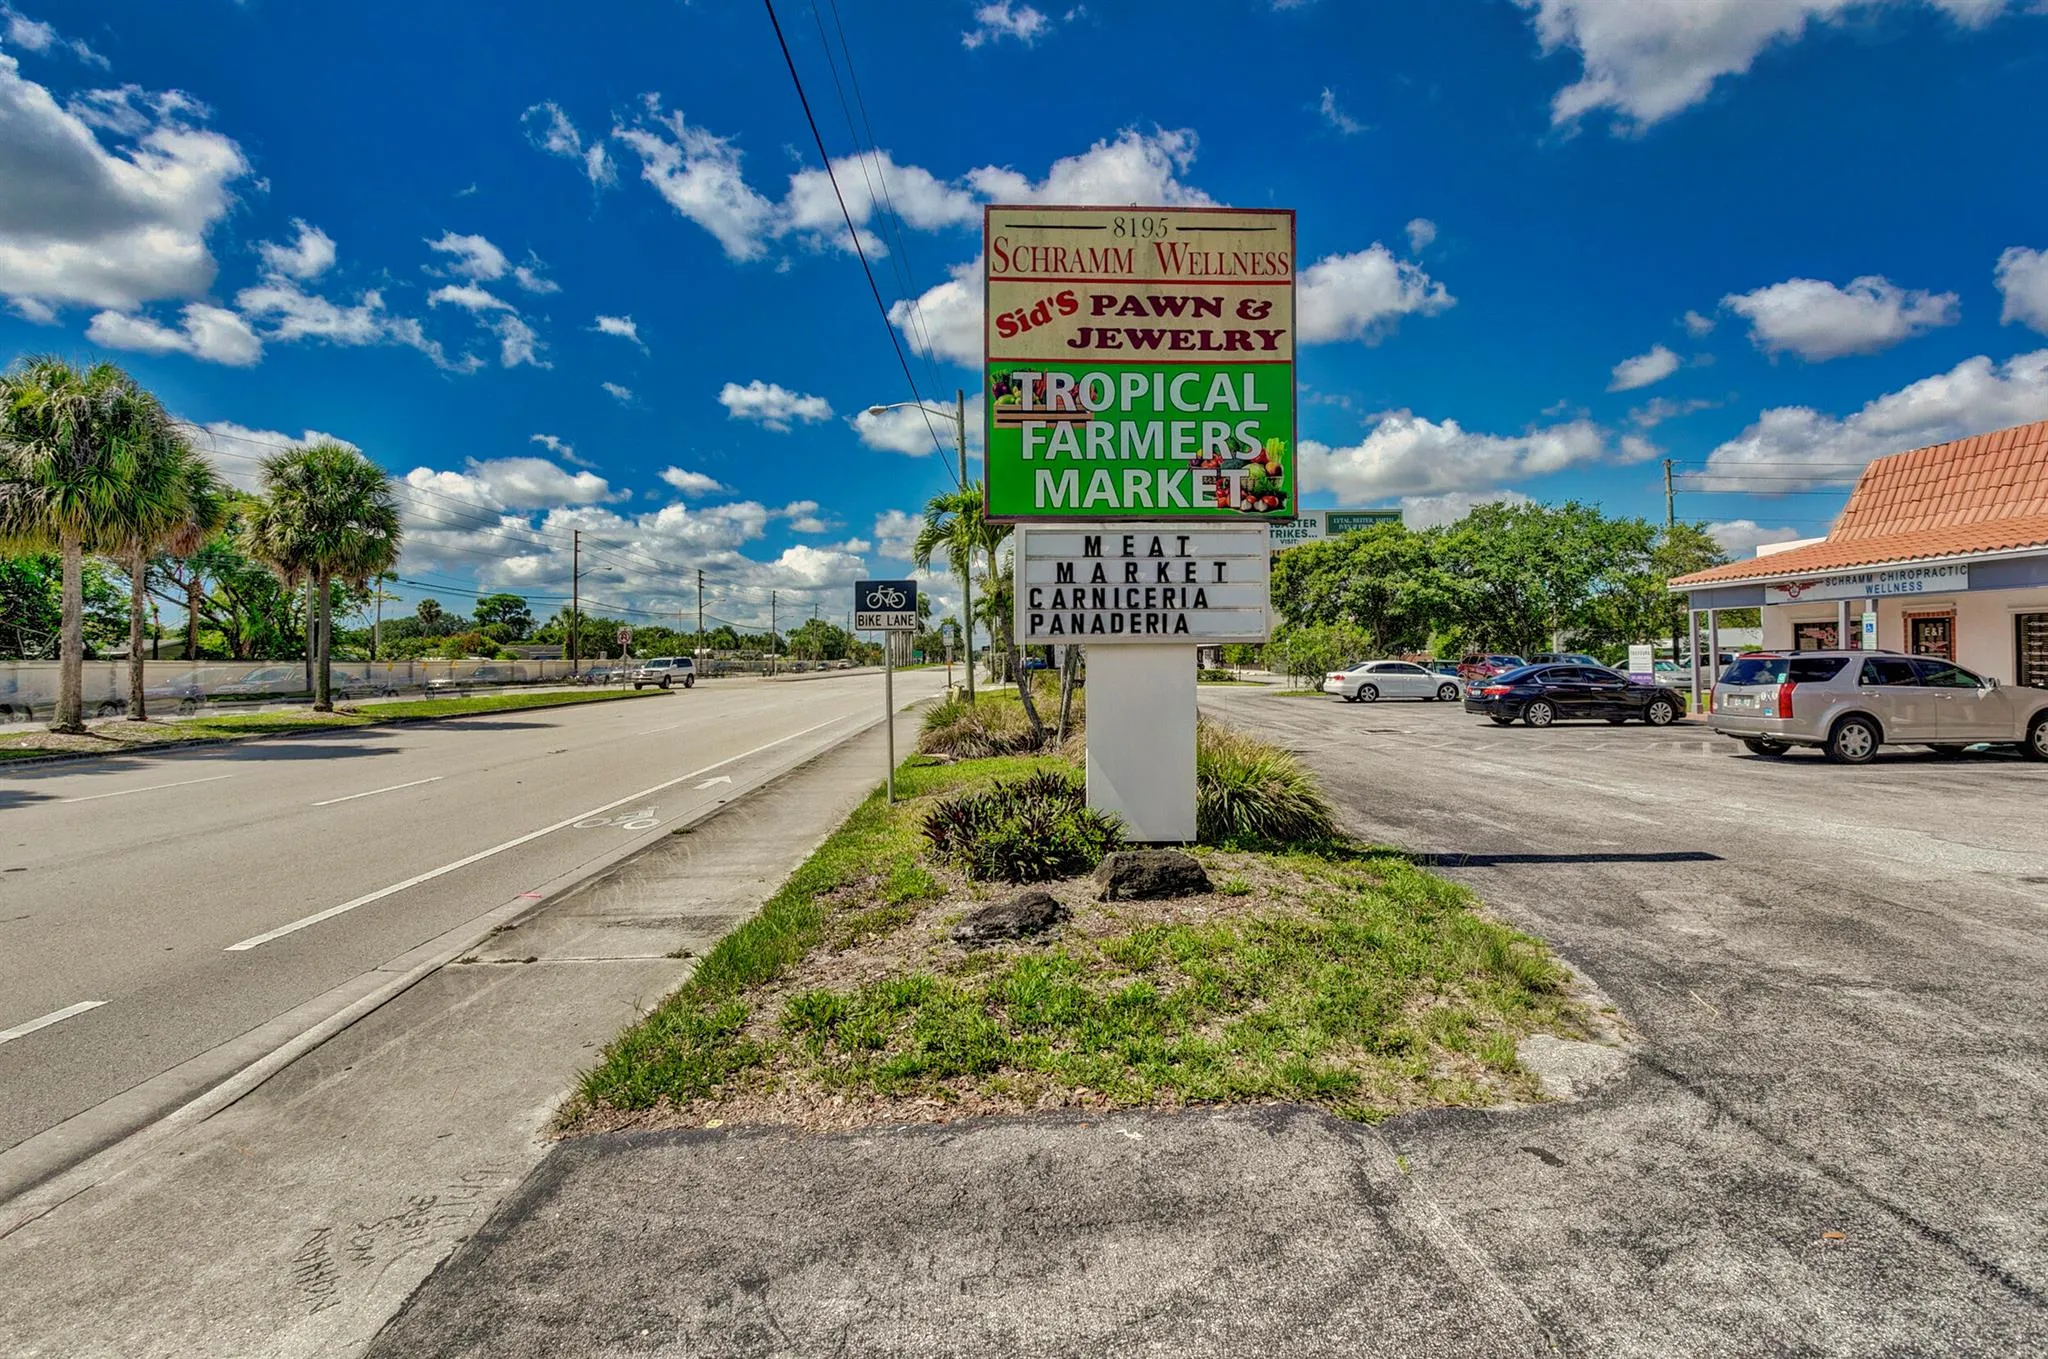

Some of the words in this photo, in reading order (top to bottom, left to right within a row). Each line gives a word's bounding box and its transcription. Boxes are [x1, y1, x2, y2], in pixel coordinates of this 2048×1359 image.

[1113, 216, 1168, 238] 8195
[992, 236, 1134, 274] SCHRAMM
[1154, 241, 1289, 276] WELLNESS
[1089, 295, 1224, 318] PAWN
[1236, 299, 1272, 320] &
[1067, 327, 1287, 351] JEWELRY
[1012, 371, 1269, 413] TROPICAL
[1021, 420, 1261, 461] FARMERS
[1034, 468, 1249, 508] MARKET
[1269, 529, 1318, 539] TRIKES...
[1083, 535, 1192, 557] MEAT
[1055, 562, 1228, 584] MARKET
[1825, 574, 1873, 587] SCHRAMM
[1879, 565, 1967, 582] CHIROPRACTIC
[1029, 587, 1209, 609] CARNICERIA
[1865, 581, 1923, 595] WELLNESS
[857, 614, 881, 627] BIKE
[886, 614, 914, 627] LANE
[1030, 613, 1189, 635] PANADERIA
